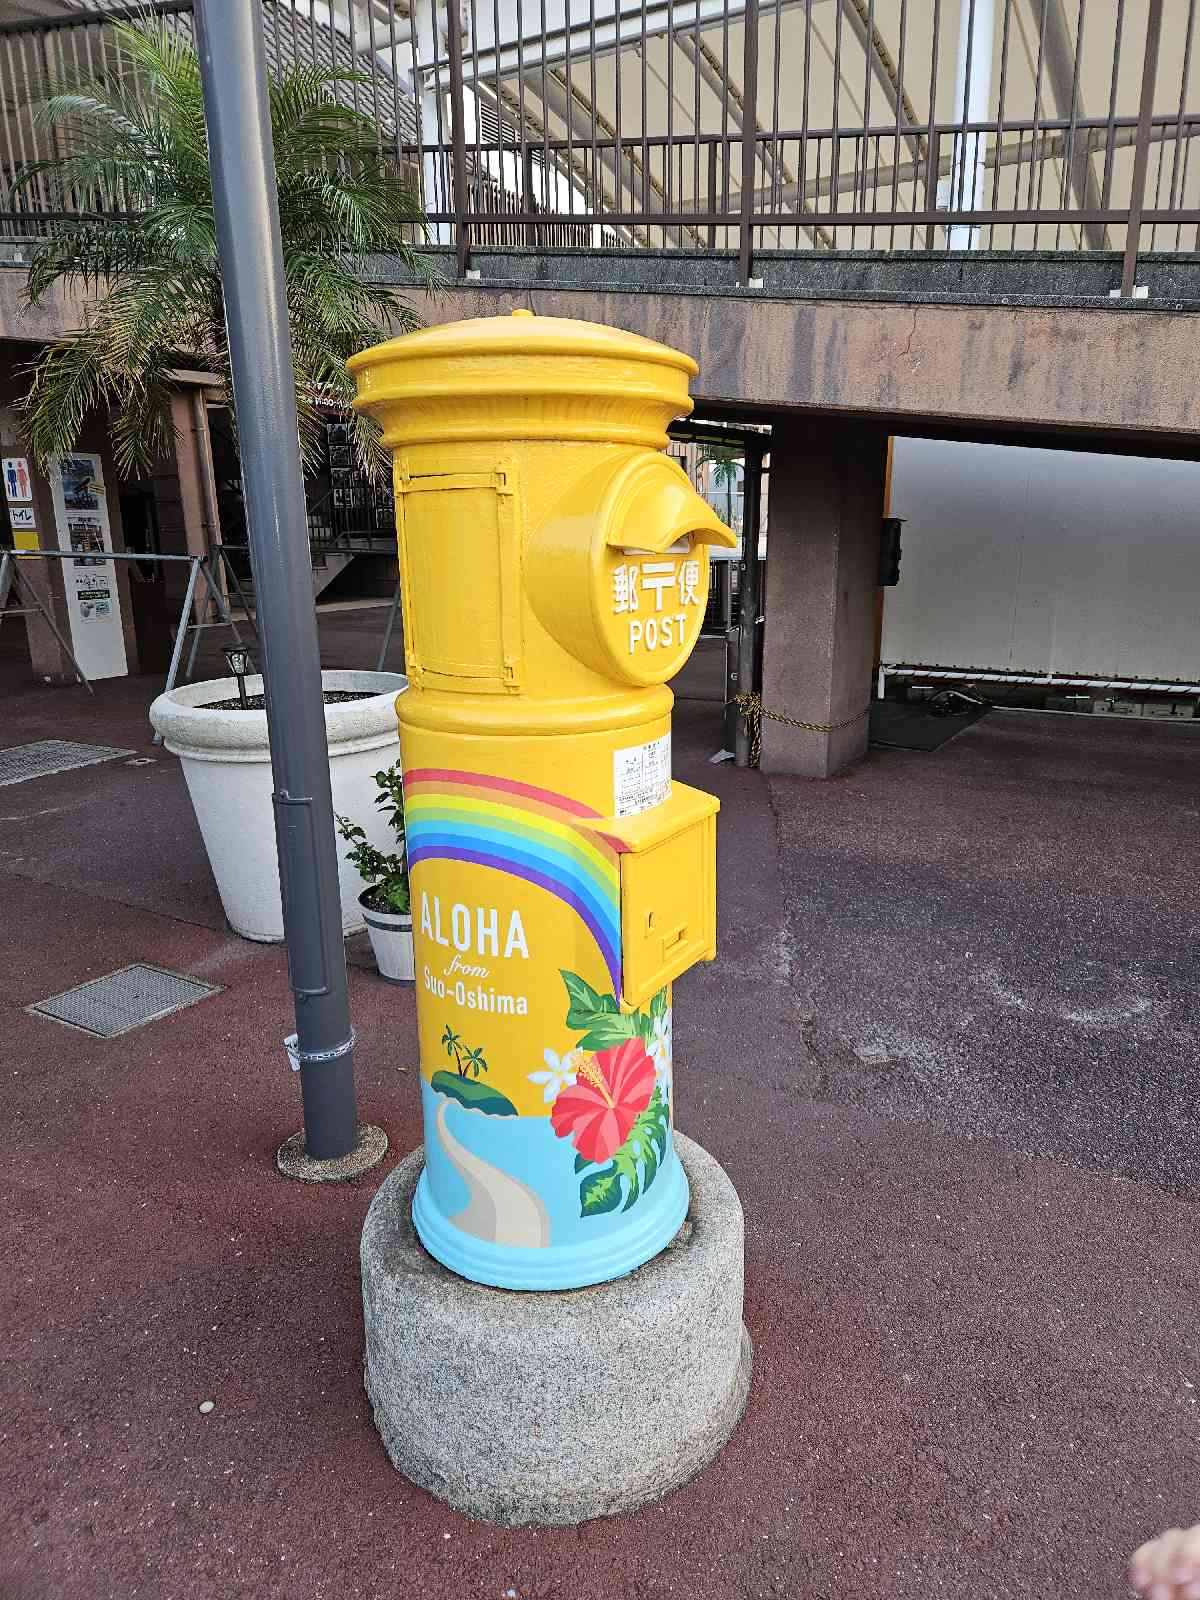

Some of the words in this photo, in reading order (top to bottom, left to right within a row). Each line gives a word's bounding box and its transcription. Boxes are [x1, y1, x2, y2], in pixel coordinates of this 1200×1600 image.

[12, 509, 32, 521] トイレ
[629, 614, 687, 655] POST
[421, 890, 529, 959] ALOHA
[443, 953, 490, 978] from
[424, 965, 529, 1016] Suo-Oshima
